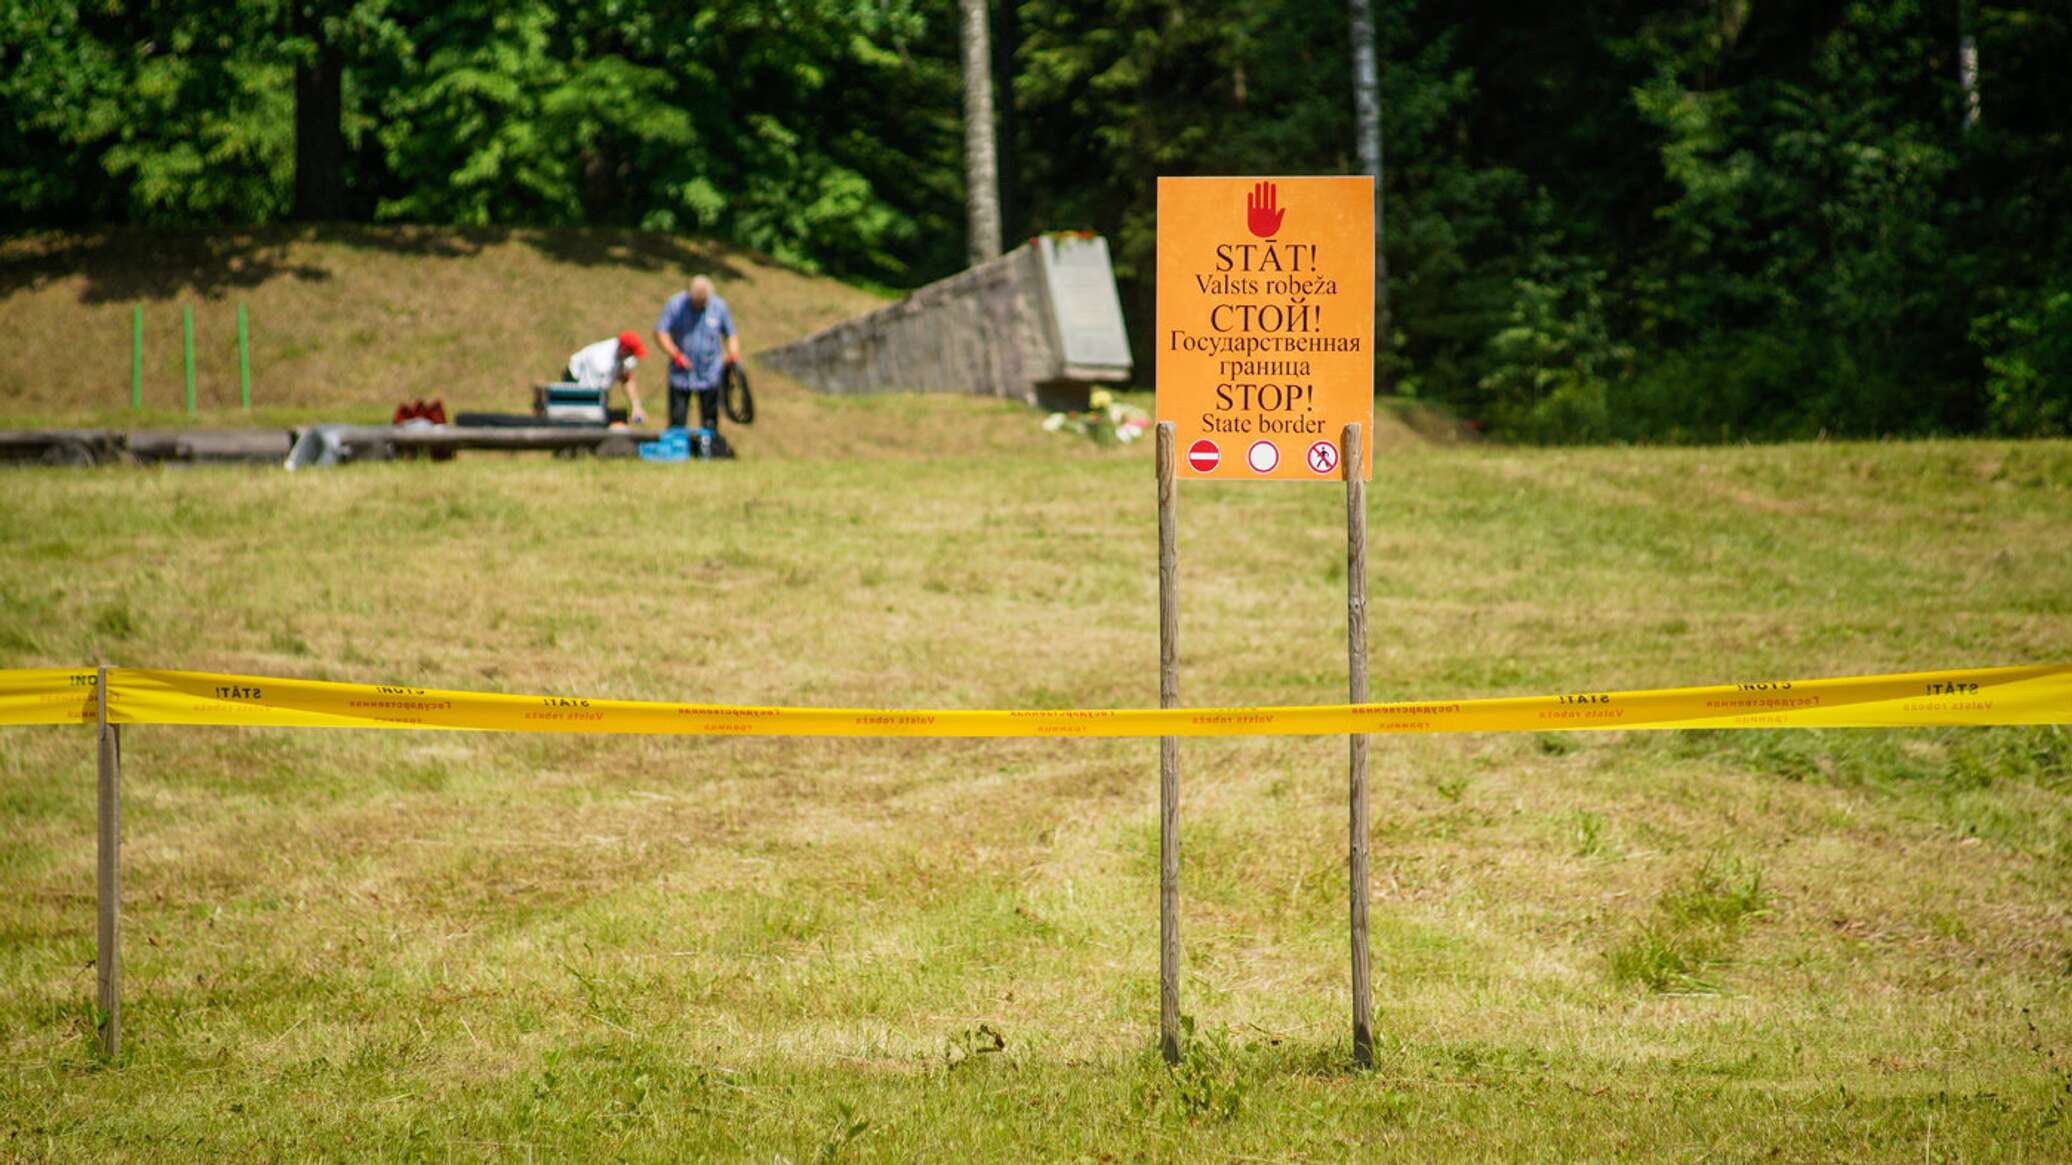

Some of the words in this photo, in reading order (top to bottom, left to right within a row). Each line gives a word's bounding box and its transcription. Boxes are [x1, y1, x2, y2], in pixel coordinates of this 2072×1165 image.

[1215, 240, 1317, 272] STĀT!
[1196, 274, 1258, 295] Valsts
[1266, 275, 1337, 295] robeža
[1210, 297, 1320, 333] СТОЙ!
[1170, 330, 1361, 357] Государственная
[1220, 360, 1311, 381] граница
[1215, 384, 1313, 412] STOP!
[1202, 413, 1252, 434] State
[1258, 413, 1326, 434] border
